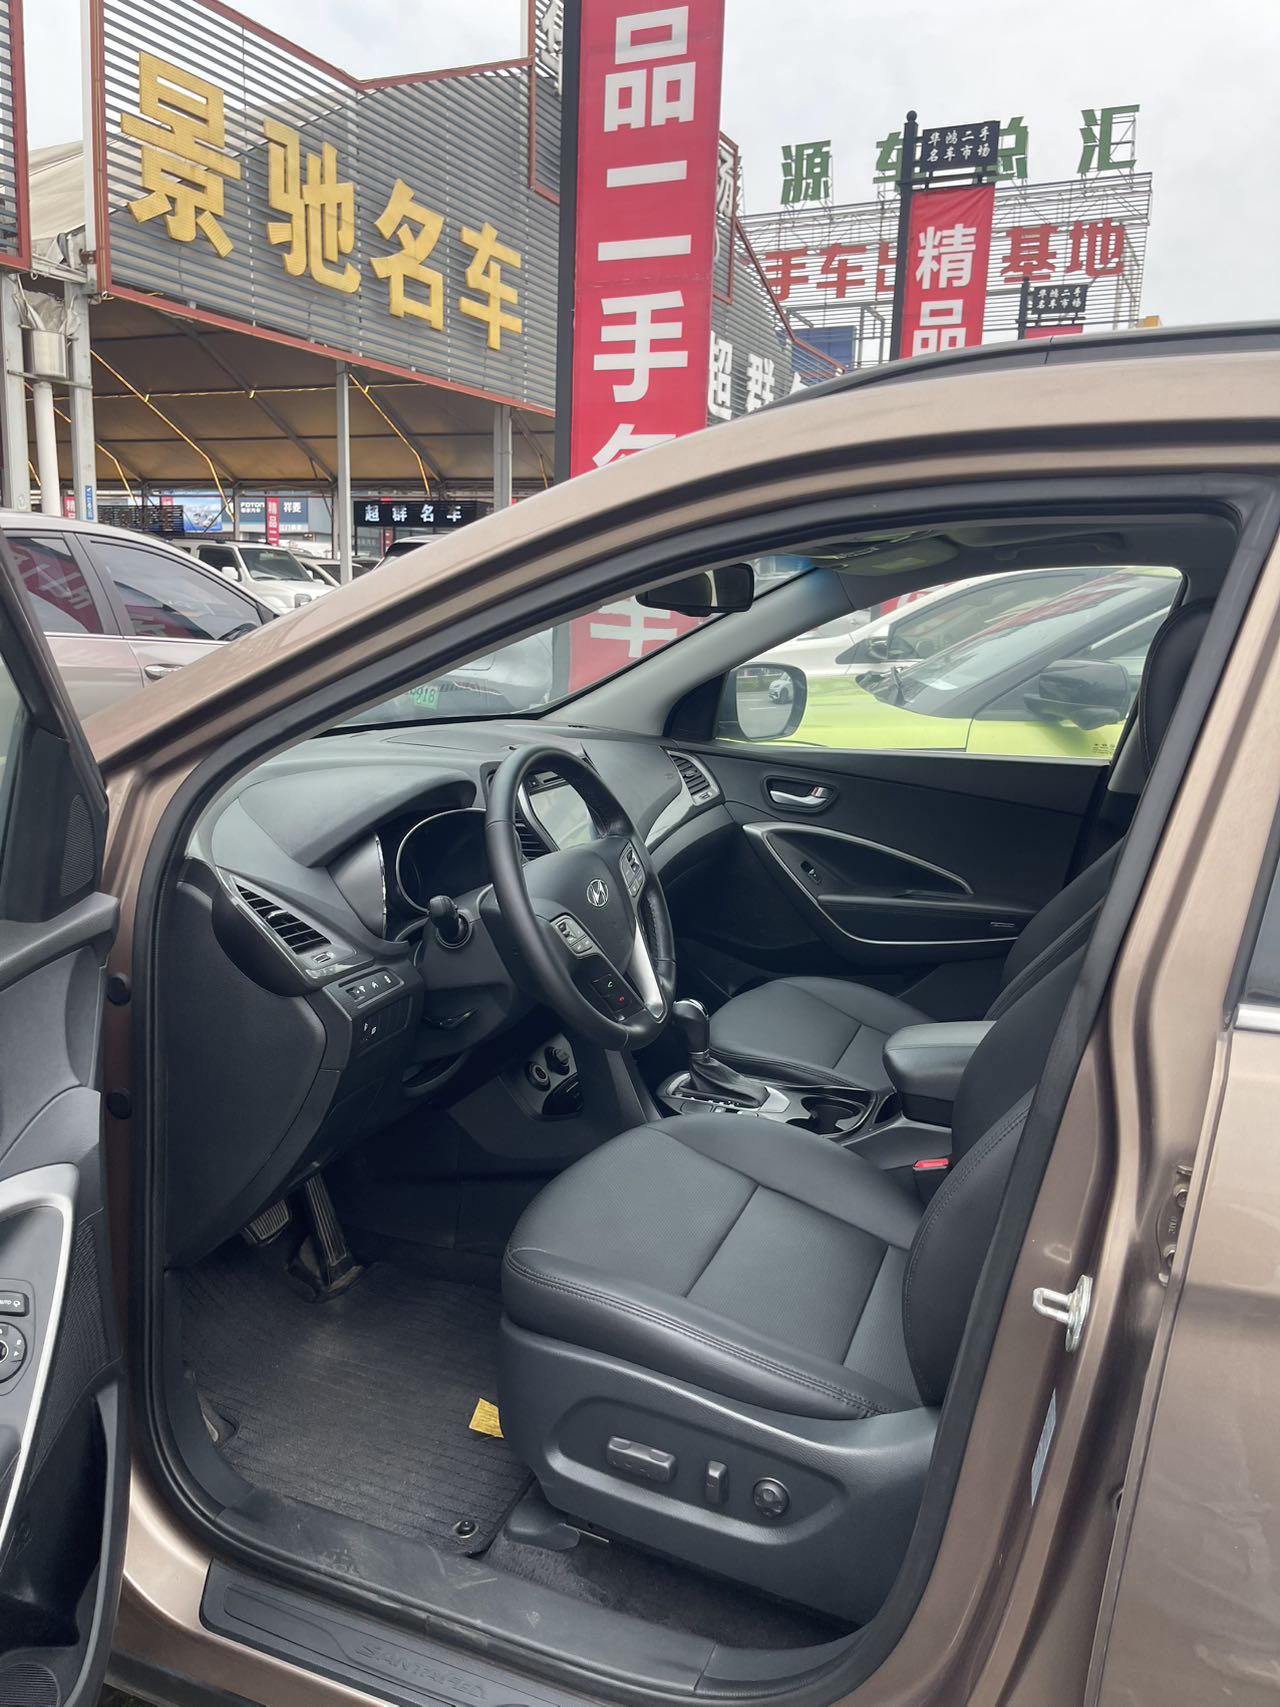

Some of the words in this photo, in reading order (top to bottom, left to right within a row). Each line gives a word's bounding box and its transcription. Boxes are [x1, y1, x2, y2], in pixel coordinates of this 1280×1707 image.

[927, 125, 991, 147] 华鸿二手
[926, 143, 991, 163] 名车市场
[120, 50, 523, 351] 景驰名车
[915, 223, 977, 355] 精品
[364, 504, 462, 522] 超群名车
